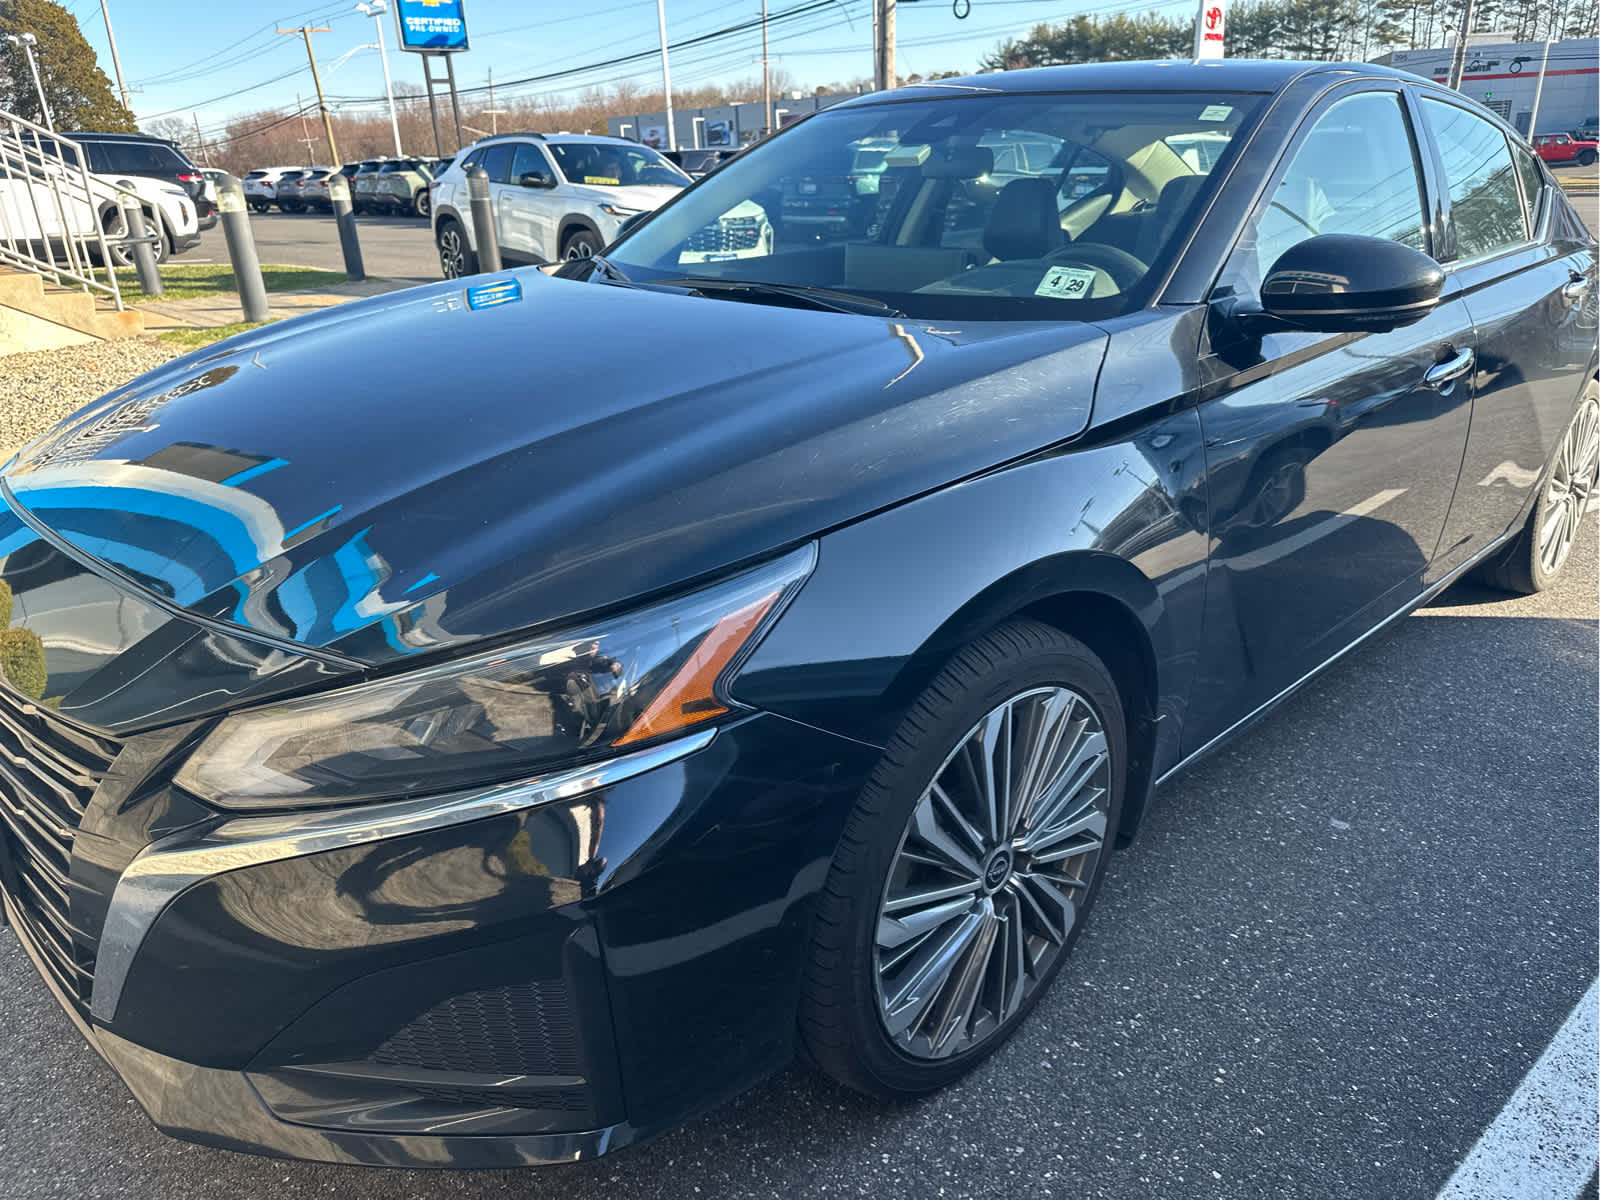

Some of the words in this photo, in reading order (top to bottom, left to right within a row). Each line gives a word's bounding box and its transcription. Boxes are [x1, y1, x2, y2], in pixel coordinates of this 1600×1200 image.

[405, 16, 461, 26] CERTIFIED
[1050, 275, 1062, 288] 4
[1065, 279, 1085, 292] 29
